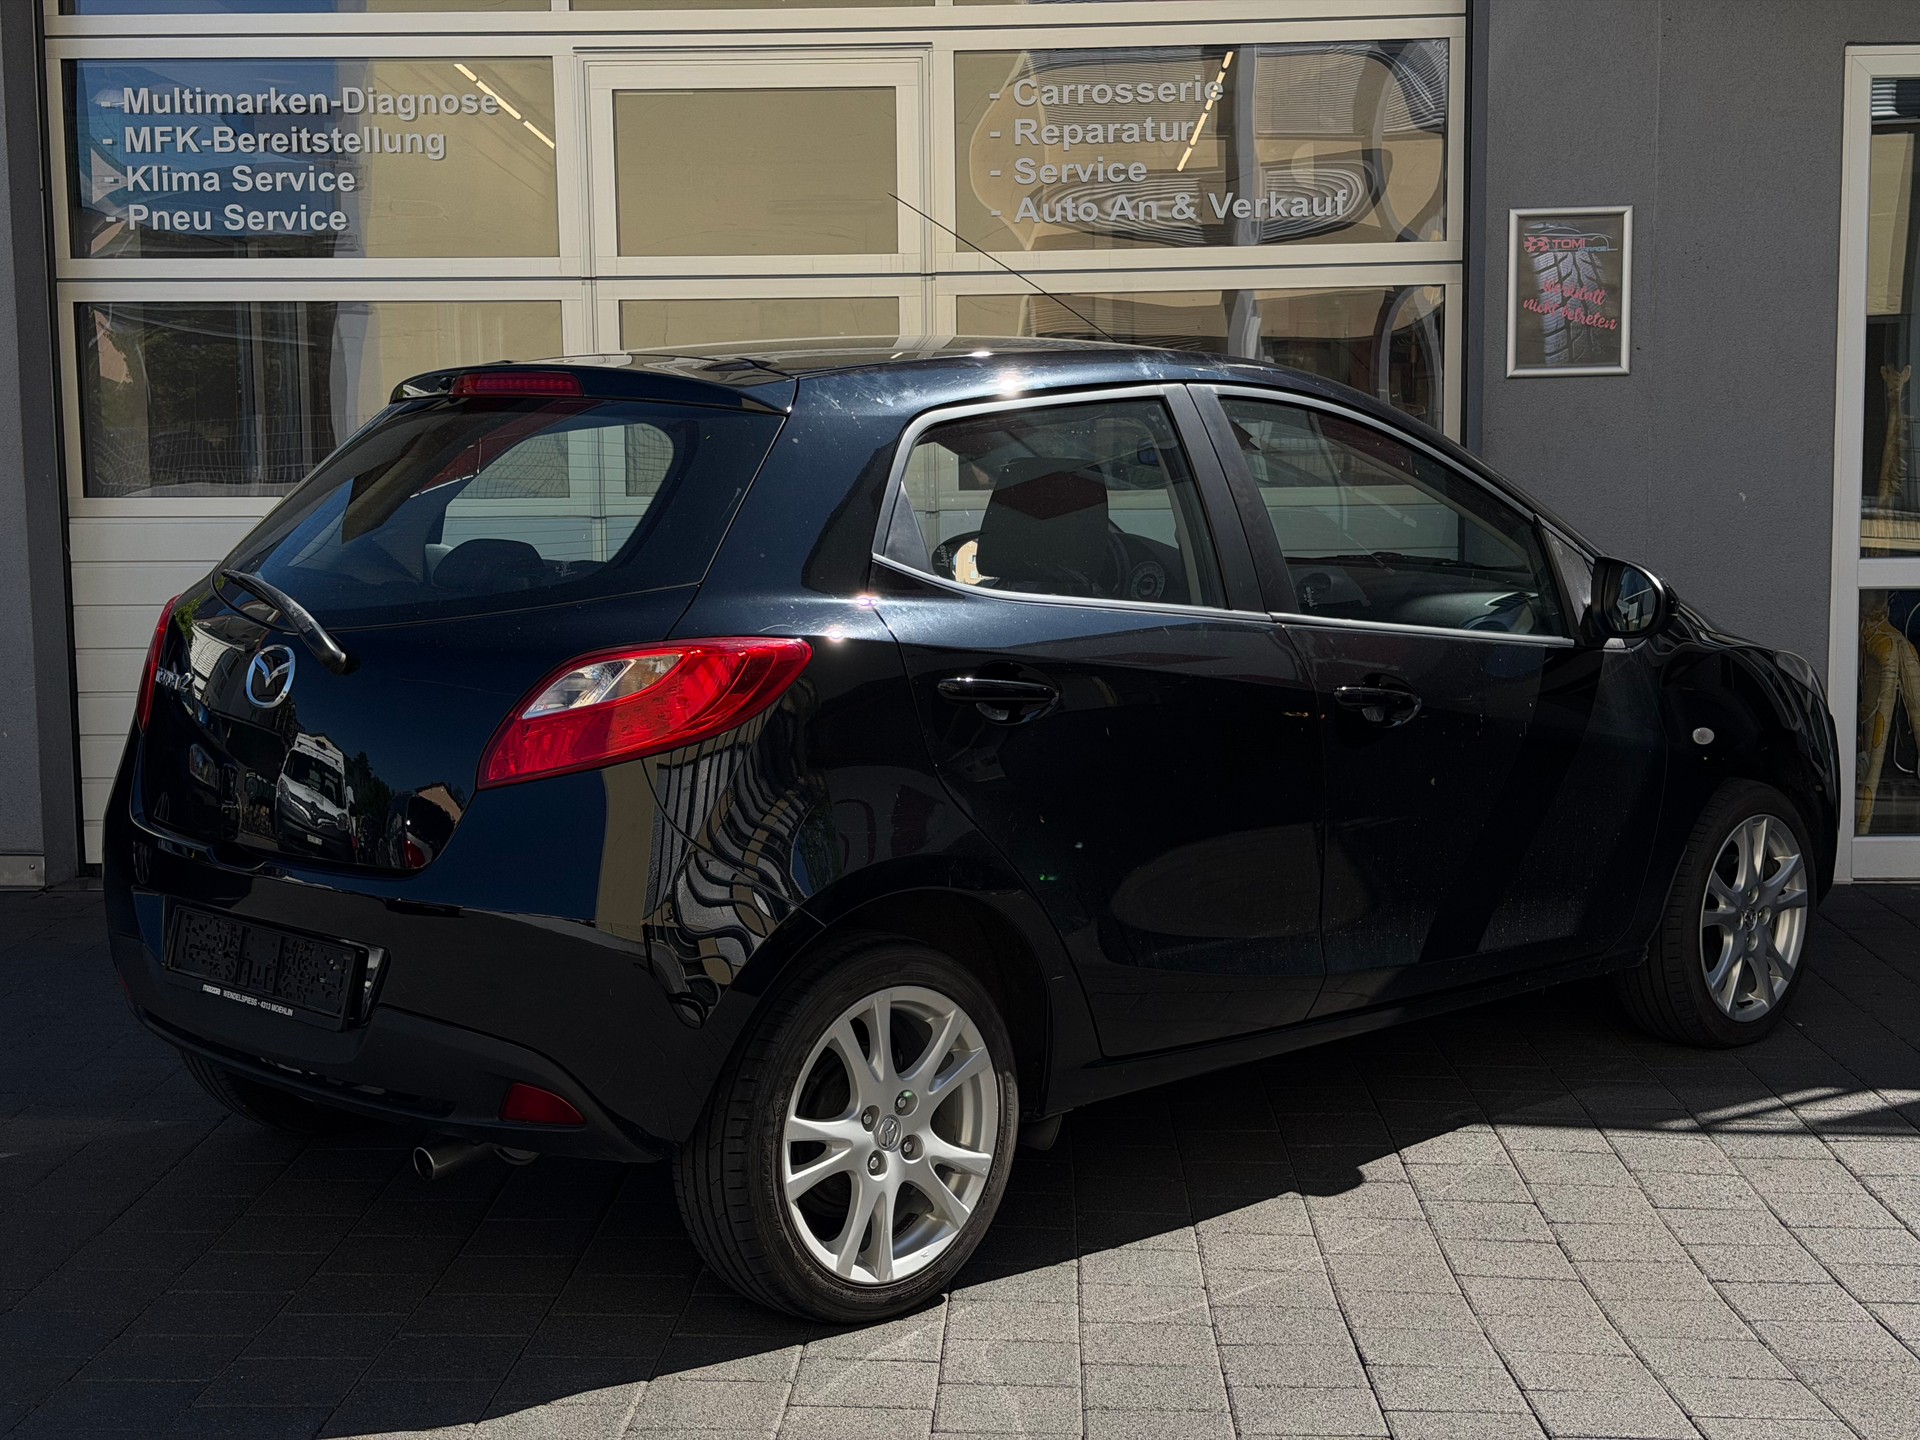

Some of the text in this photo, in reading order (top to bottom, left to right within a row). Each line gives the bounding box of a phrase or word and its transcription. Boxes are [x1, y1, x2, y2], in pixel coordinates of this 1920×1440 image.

[123, 87, 500, 121] Multimarken-Diagnose
[1013, 75, 1224, 106] Carrosserie
[125, 126, 445, 161] MFK-Bereitstellung
[1014, 116, 1195, 151] Reparatur
[126, 165, 220, 192] Klima
[232, 165, 355, 192] Service
[1014, 156, 1147, 184] Service
[128, 204, 212, 231] Pneu
[223, 204, 347, 231] Service
[1014, 197, 1098, 224] Auto
[1109, 194, 1158, 221] An
[1171, 193, 1197, 220] &
[1208, 189, 1349, 220] Verkauf
[1552, 239, 1586, 248] TOMI
